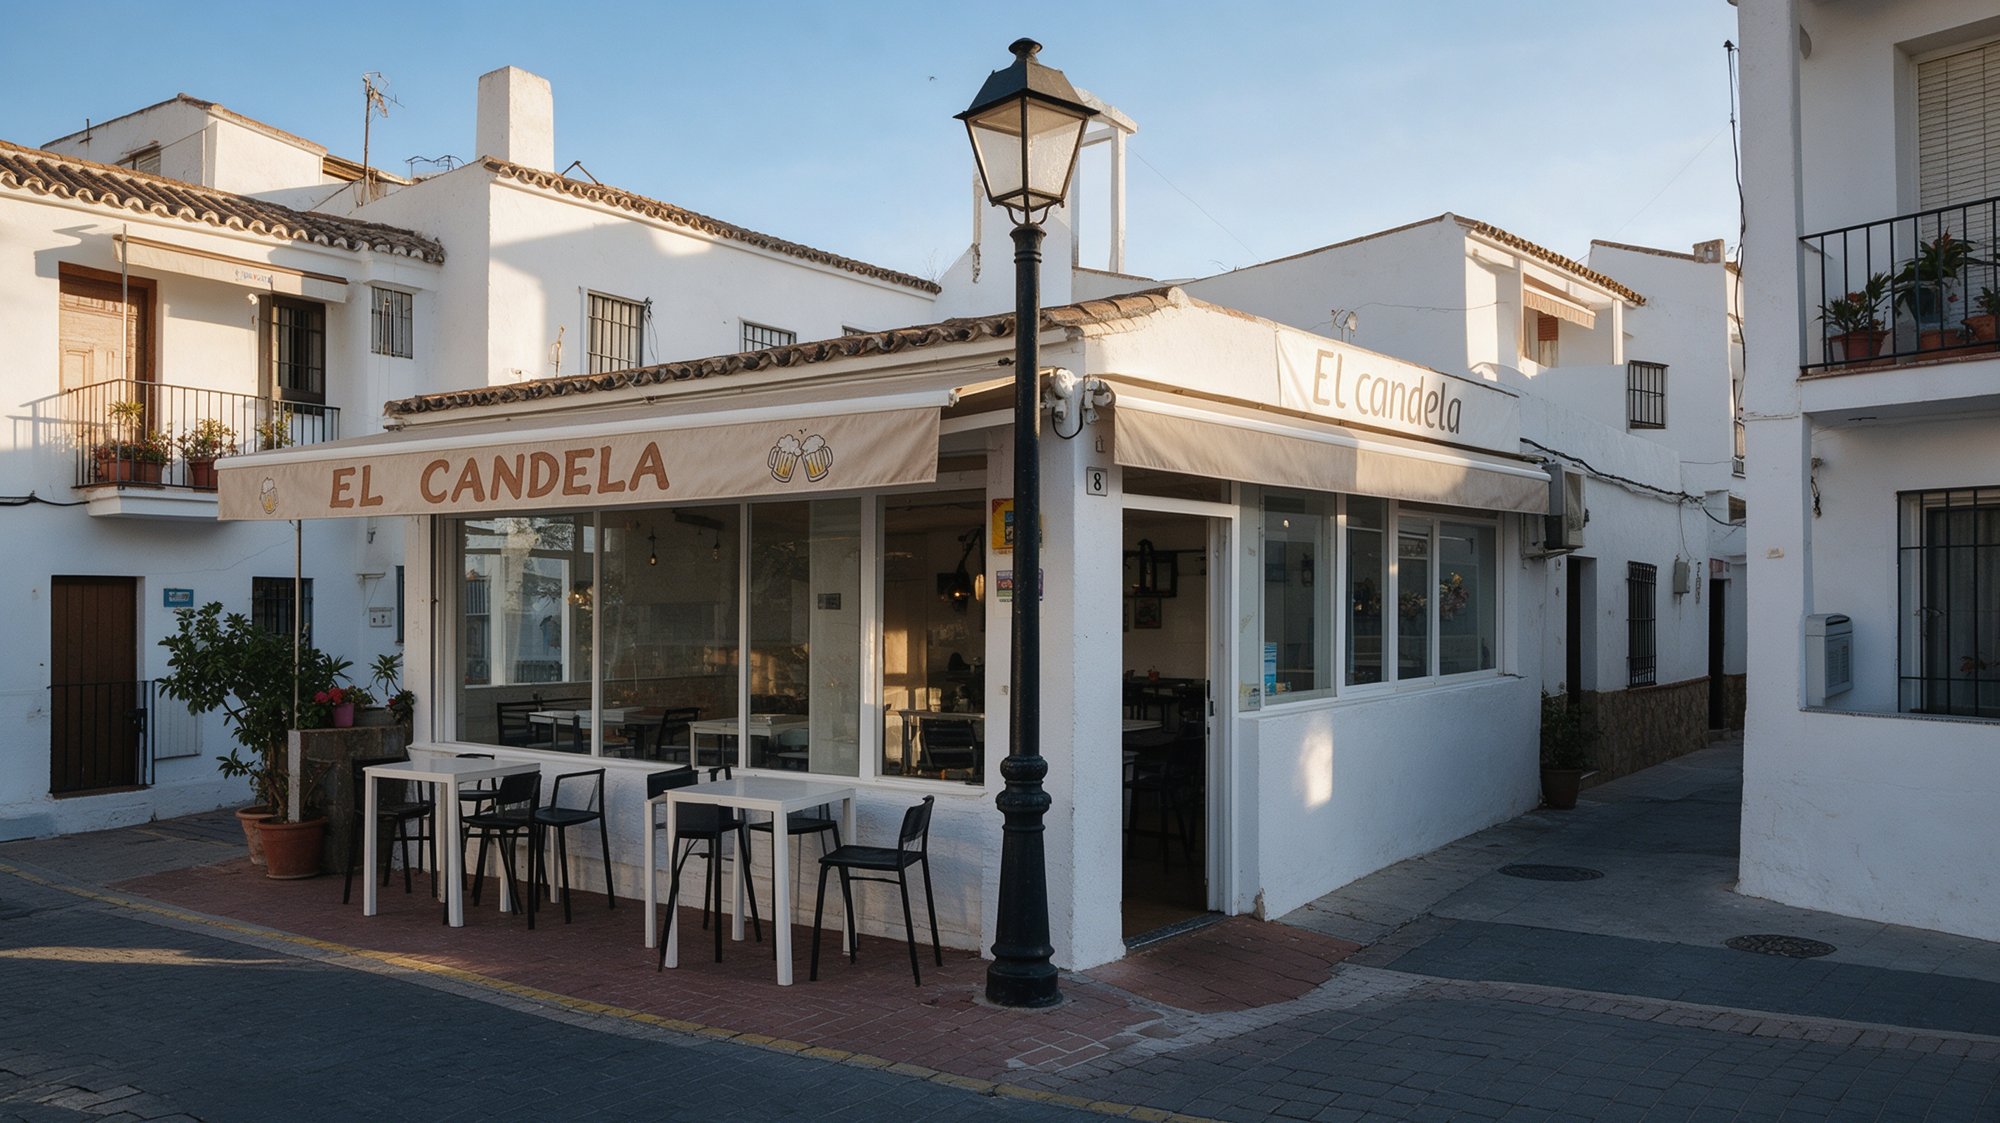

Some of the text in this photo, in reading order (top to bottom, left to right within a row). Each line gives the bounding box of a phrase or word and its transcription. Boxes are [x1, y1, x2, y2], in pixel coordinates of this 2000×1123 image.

[1312, 348, 1462, 434] El candela
[329, 441, 670, 508] EL CANDELA
[1093, 472, 1102, 491] 8
